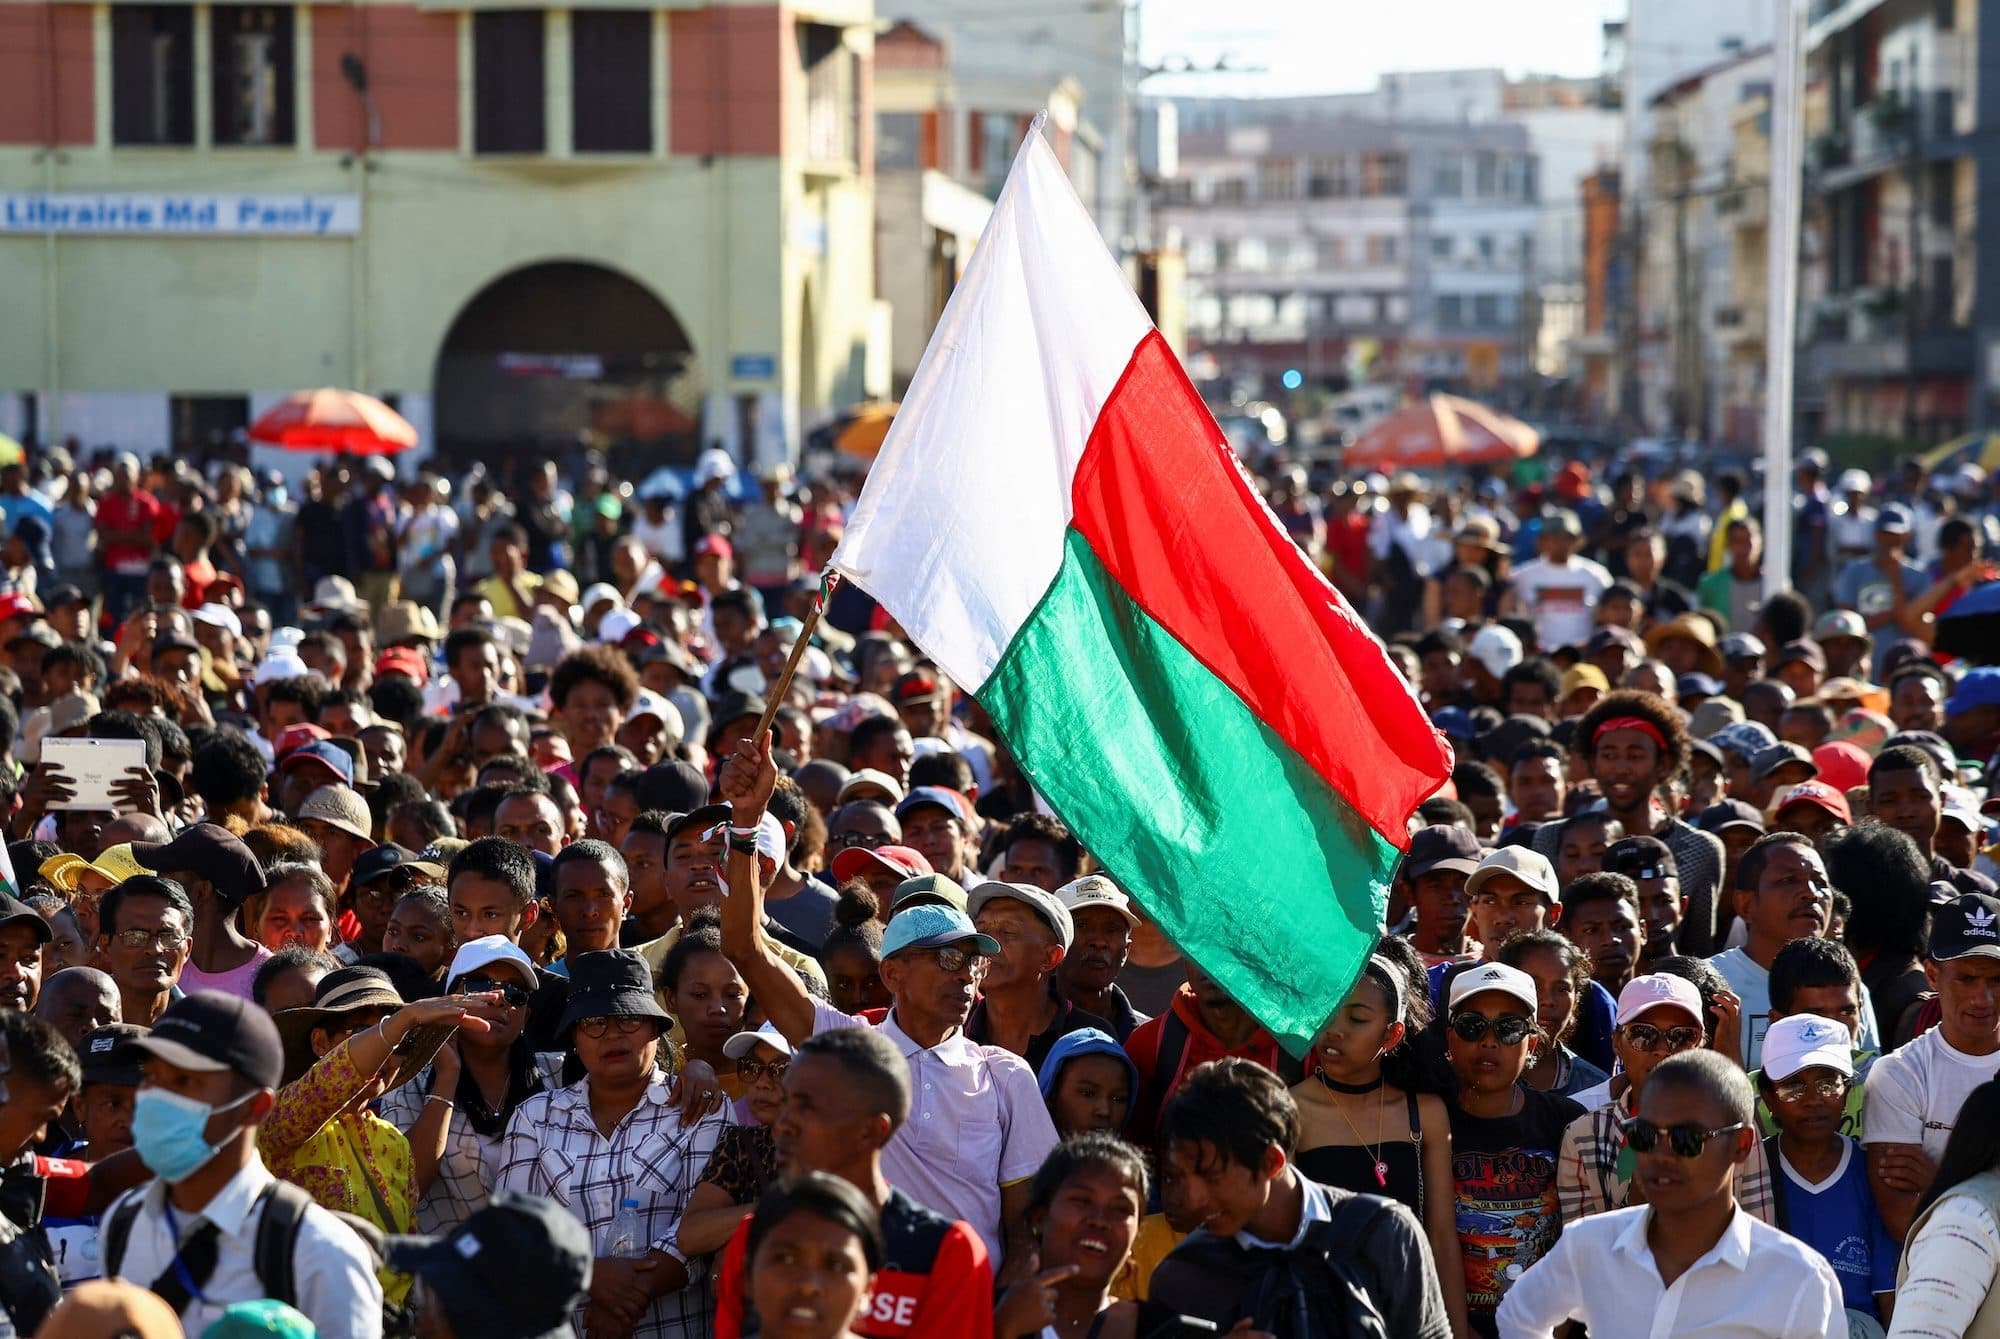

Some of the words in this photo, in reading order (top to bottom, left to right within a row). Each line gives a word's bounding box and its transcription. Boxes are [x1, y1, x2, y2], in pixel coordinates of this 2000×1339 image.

[6, 197, 152, 225] Librairie
[164, 198, 217, 225] Md
[1962, 927, 1997, 938] adidas
